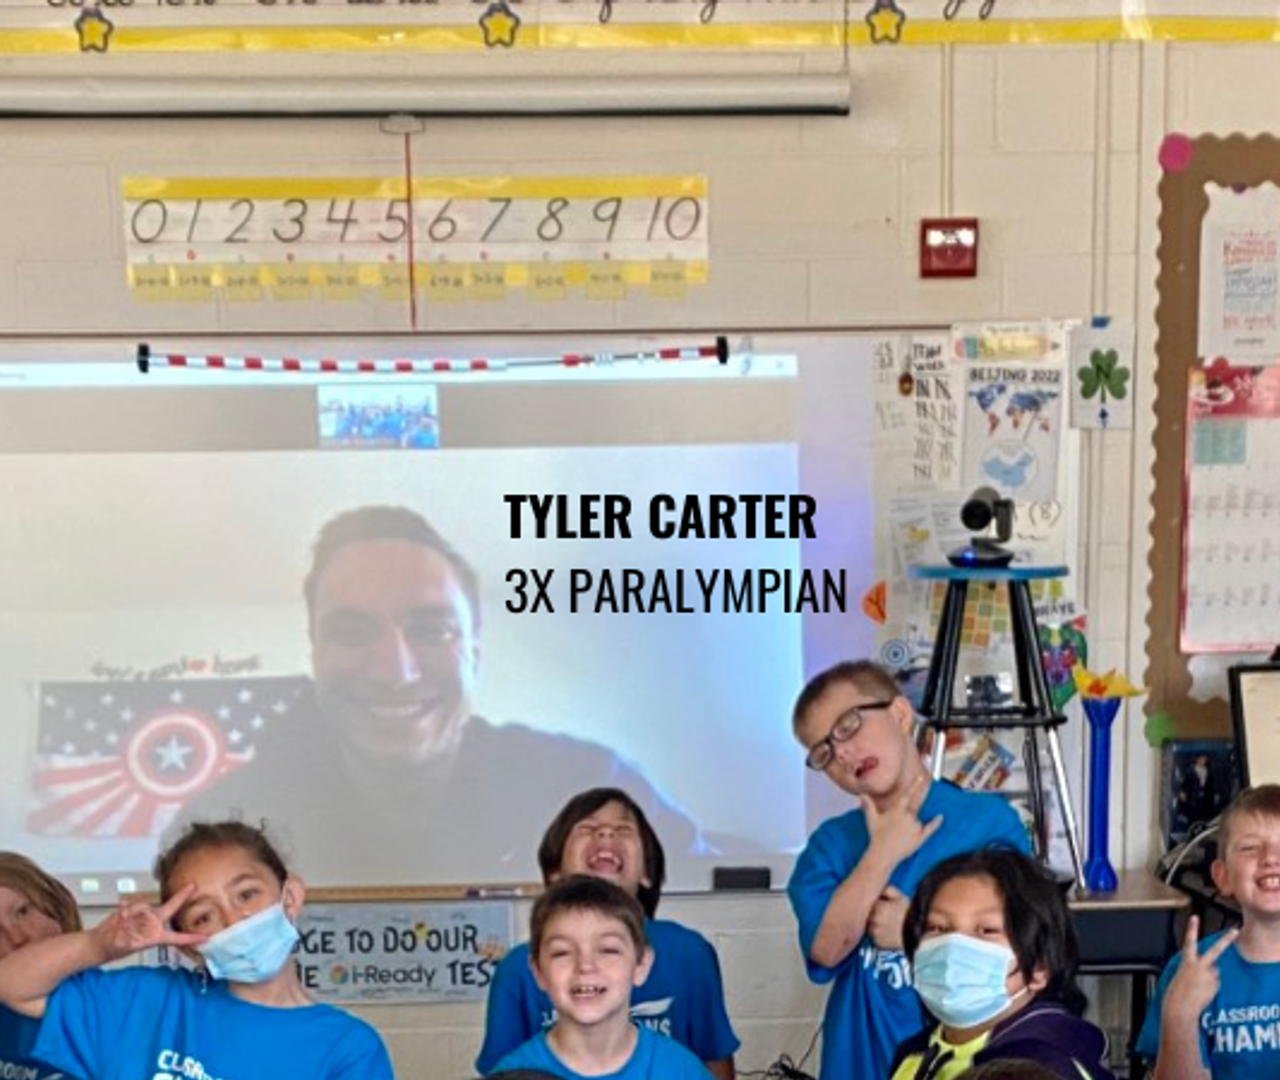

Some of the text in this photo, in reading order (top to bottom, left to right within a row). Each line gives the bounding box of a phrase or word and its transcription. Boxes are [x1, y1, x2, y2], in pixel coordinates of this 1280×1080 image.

[131, 195, 702, 244] 0 1 2 3 4 5 6 7 8 9 10
[970, 368, 1062, 383] BEIJING 2022
[300, 924, 480, 954] GE TO DO OUR
